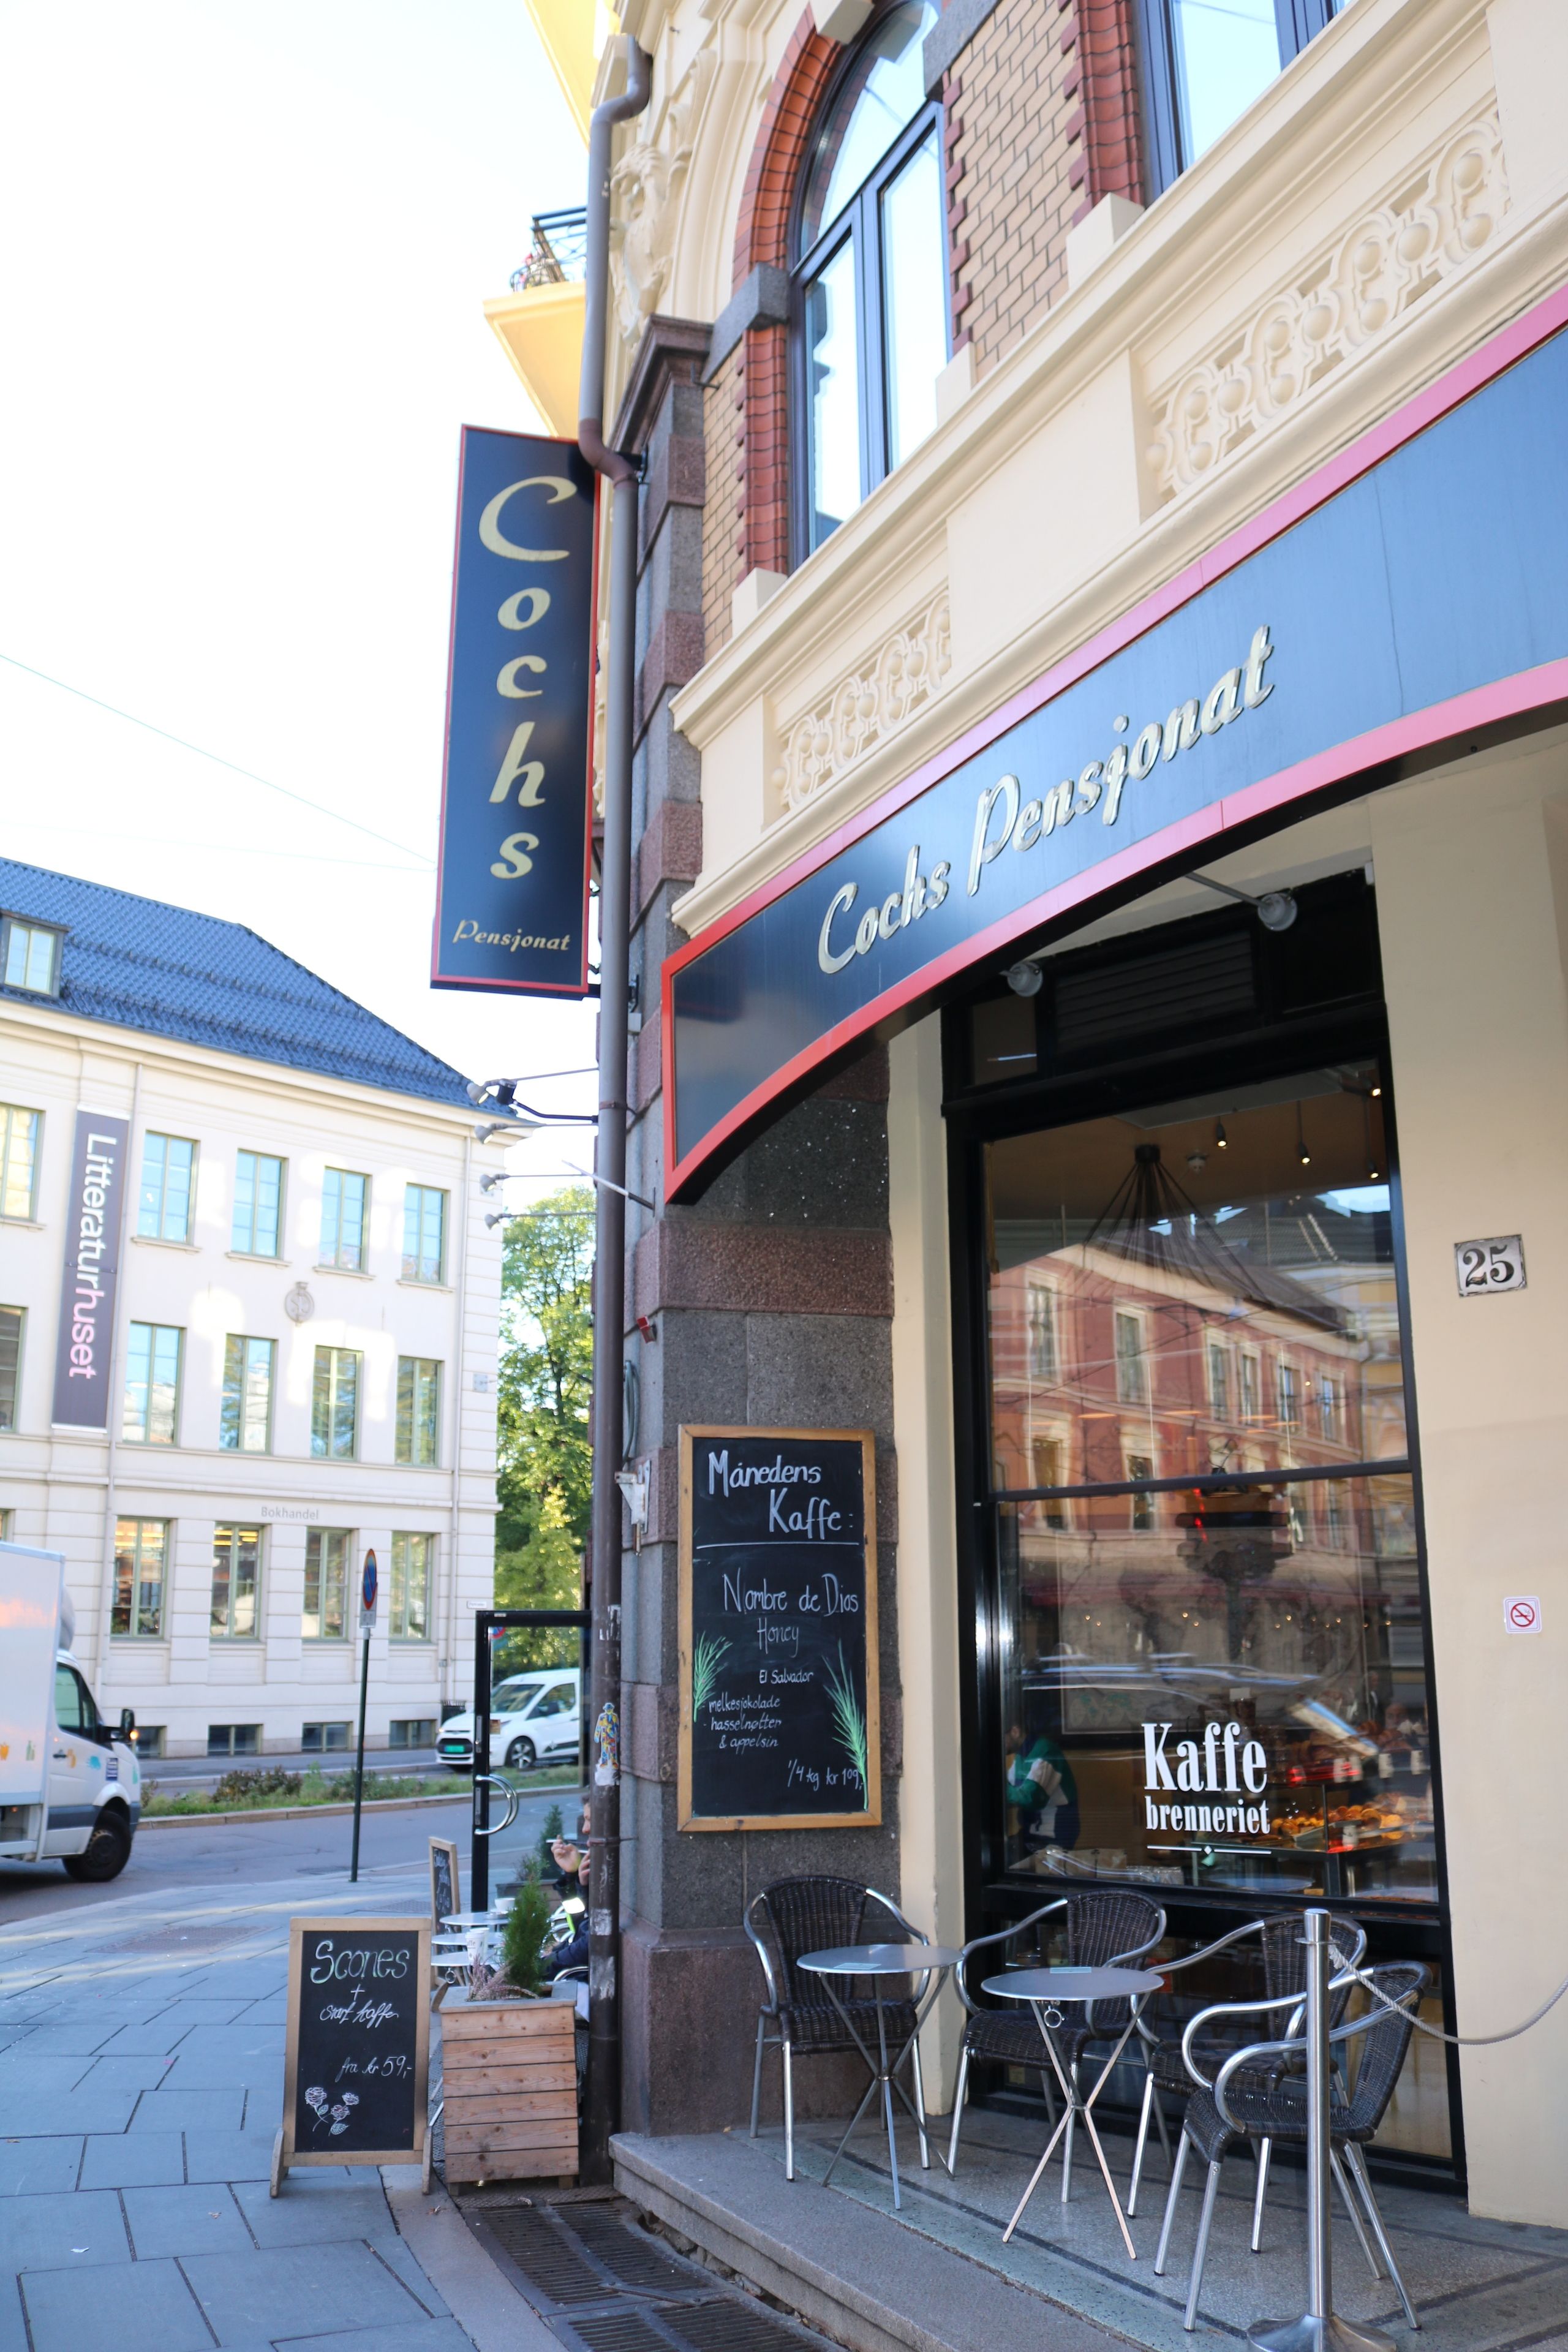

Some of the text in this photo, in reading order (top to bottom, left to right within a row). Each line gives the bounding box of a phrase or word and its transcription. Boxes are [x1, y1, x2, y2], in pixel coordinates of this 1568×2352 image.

[478, 475, 578, 879] Cochs
[818, 624, 1275, 974] Cochs Pensjonat
[452, 919, 570, 952] Pensjonat
[69, 1133, 118, 1379] Litteraturhuset
[1463, 1244, 1515, 1287] 25
[261, 1507, 319, 1520] Bokhandel
[723, 1568, 788, 1612] Nombre
[798, 1585, 821, 1611] de
[756, 1616, 799, 1657] Honey
[760, 1667, 813, 1684] El Salvador
[729, 1733, 779, 1754] appelsin
[1142, 1722, 1267, 1794] Kaffe
[805, 1767, 820, 1792] kg
[826, 1766, 839, 1785] kr
[1145, 1796, 1270, 1834] brenneriet
[311, 1940, 409, 1985] Scones
[334, 2057, 358, 2082] fra
